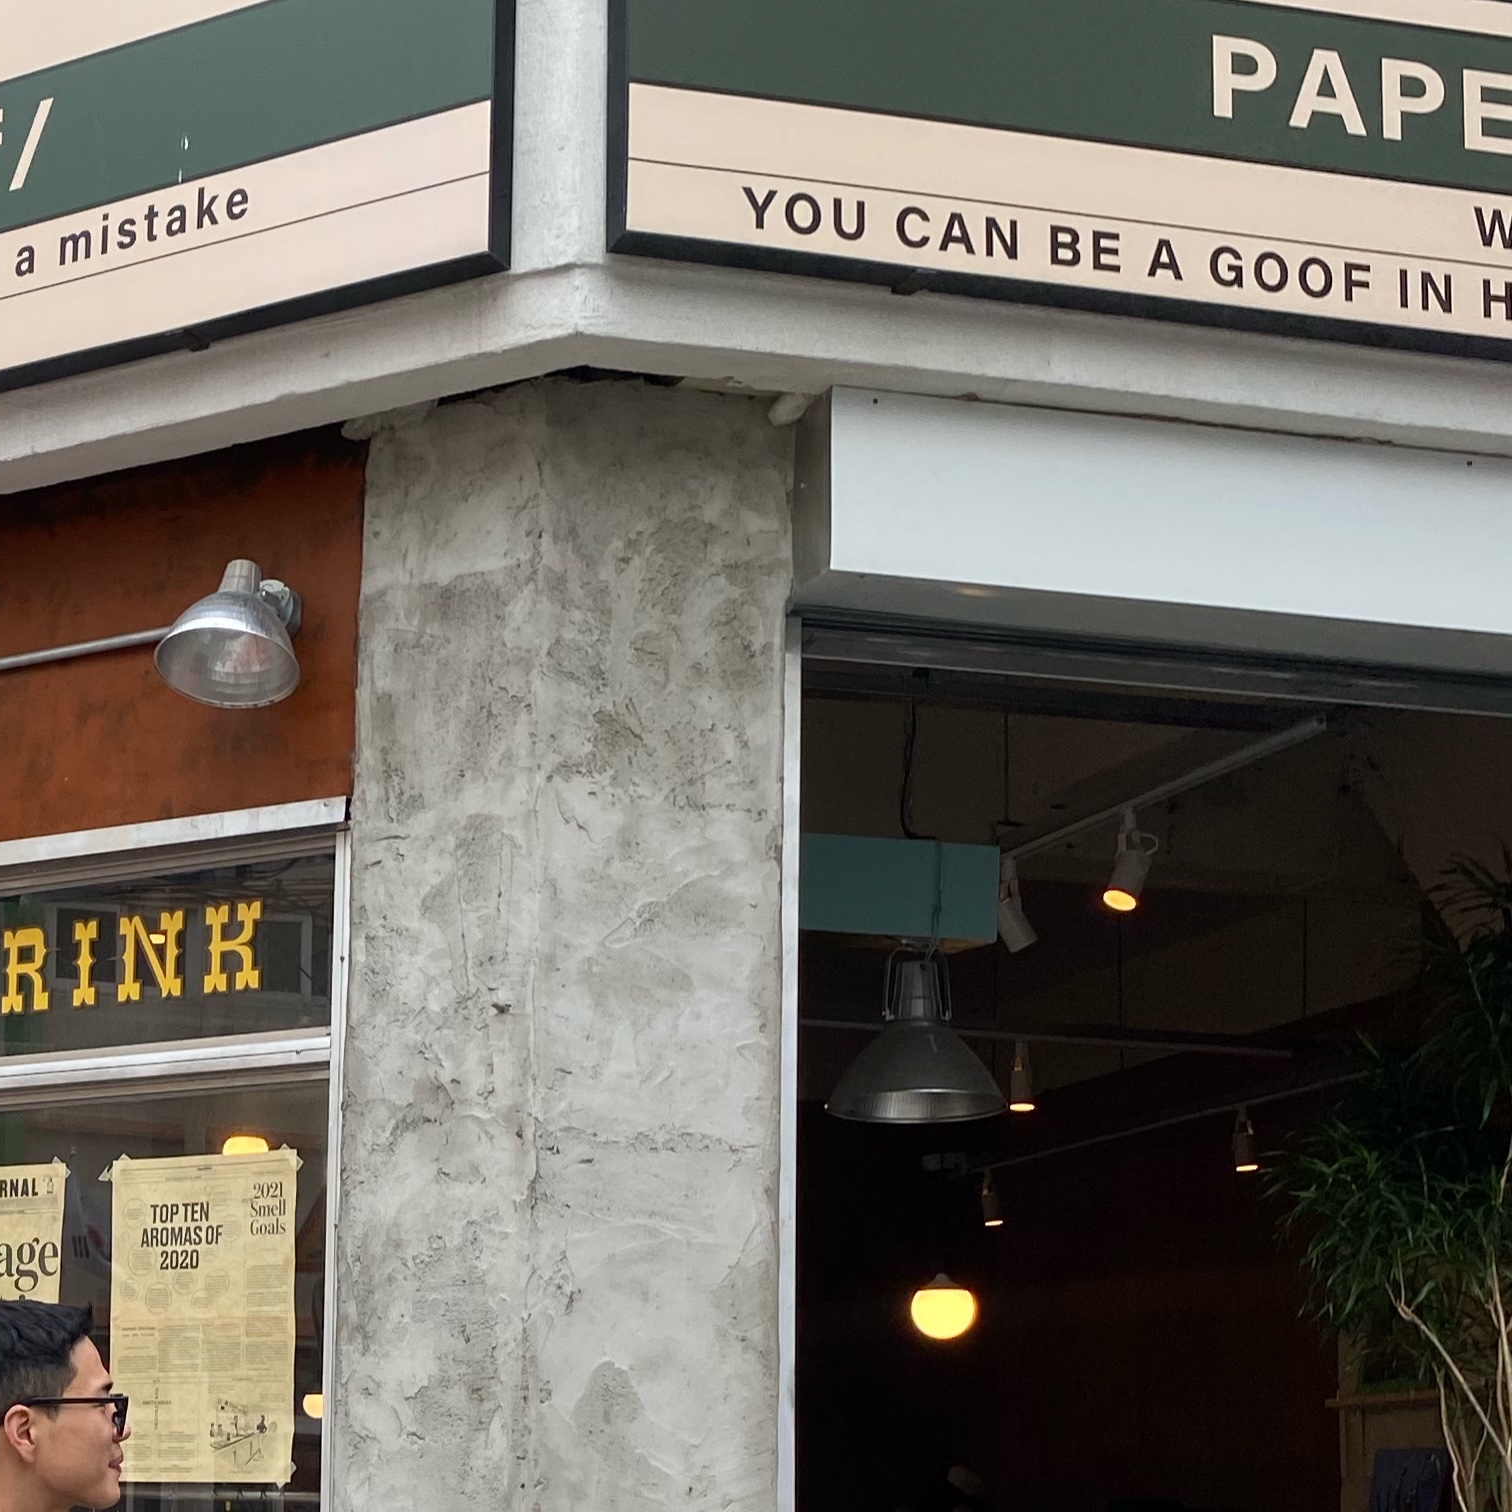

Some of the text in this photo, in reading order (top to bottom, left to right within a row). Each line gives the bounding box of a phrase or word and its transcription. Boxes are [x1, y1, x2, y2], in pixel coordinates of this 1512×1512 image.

[15, 244, 36, 276] a
[59, 183, 250, 266] mistake
[742, 186, 866, 242] YOU
[896, 205, 1020, 262] CAN
[1050, 225, 1122, 274] BE
[1147, 237, 1184, 282] A
[1210, 246, 1372, 303] GOOF
[1399, 268, 1453, 315] IN
[252, 1181, 284, 1199] 2021
[150, 1201, 210, 1224] TOP TEN
[250, 1199, 287, 1218] Smell
[140, 1225, 224, 1248] AROMAS OF
[250, 1218, 287, 1236] Goals
[160, 1249, 200, 1270] 2020
